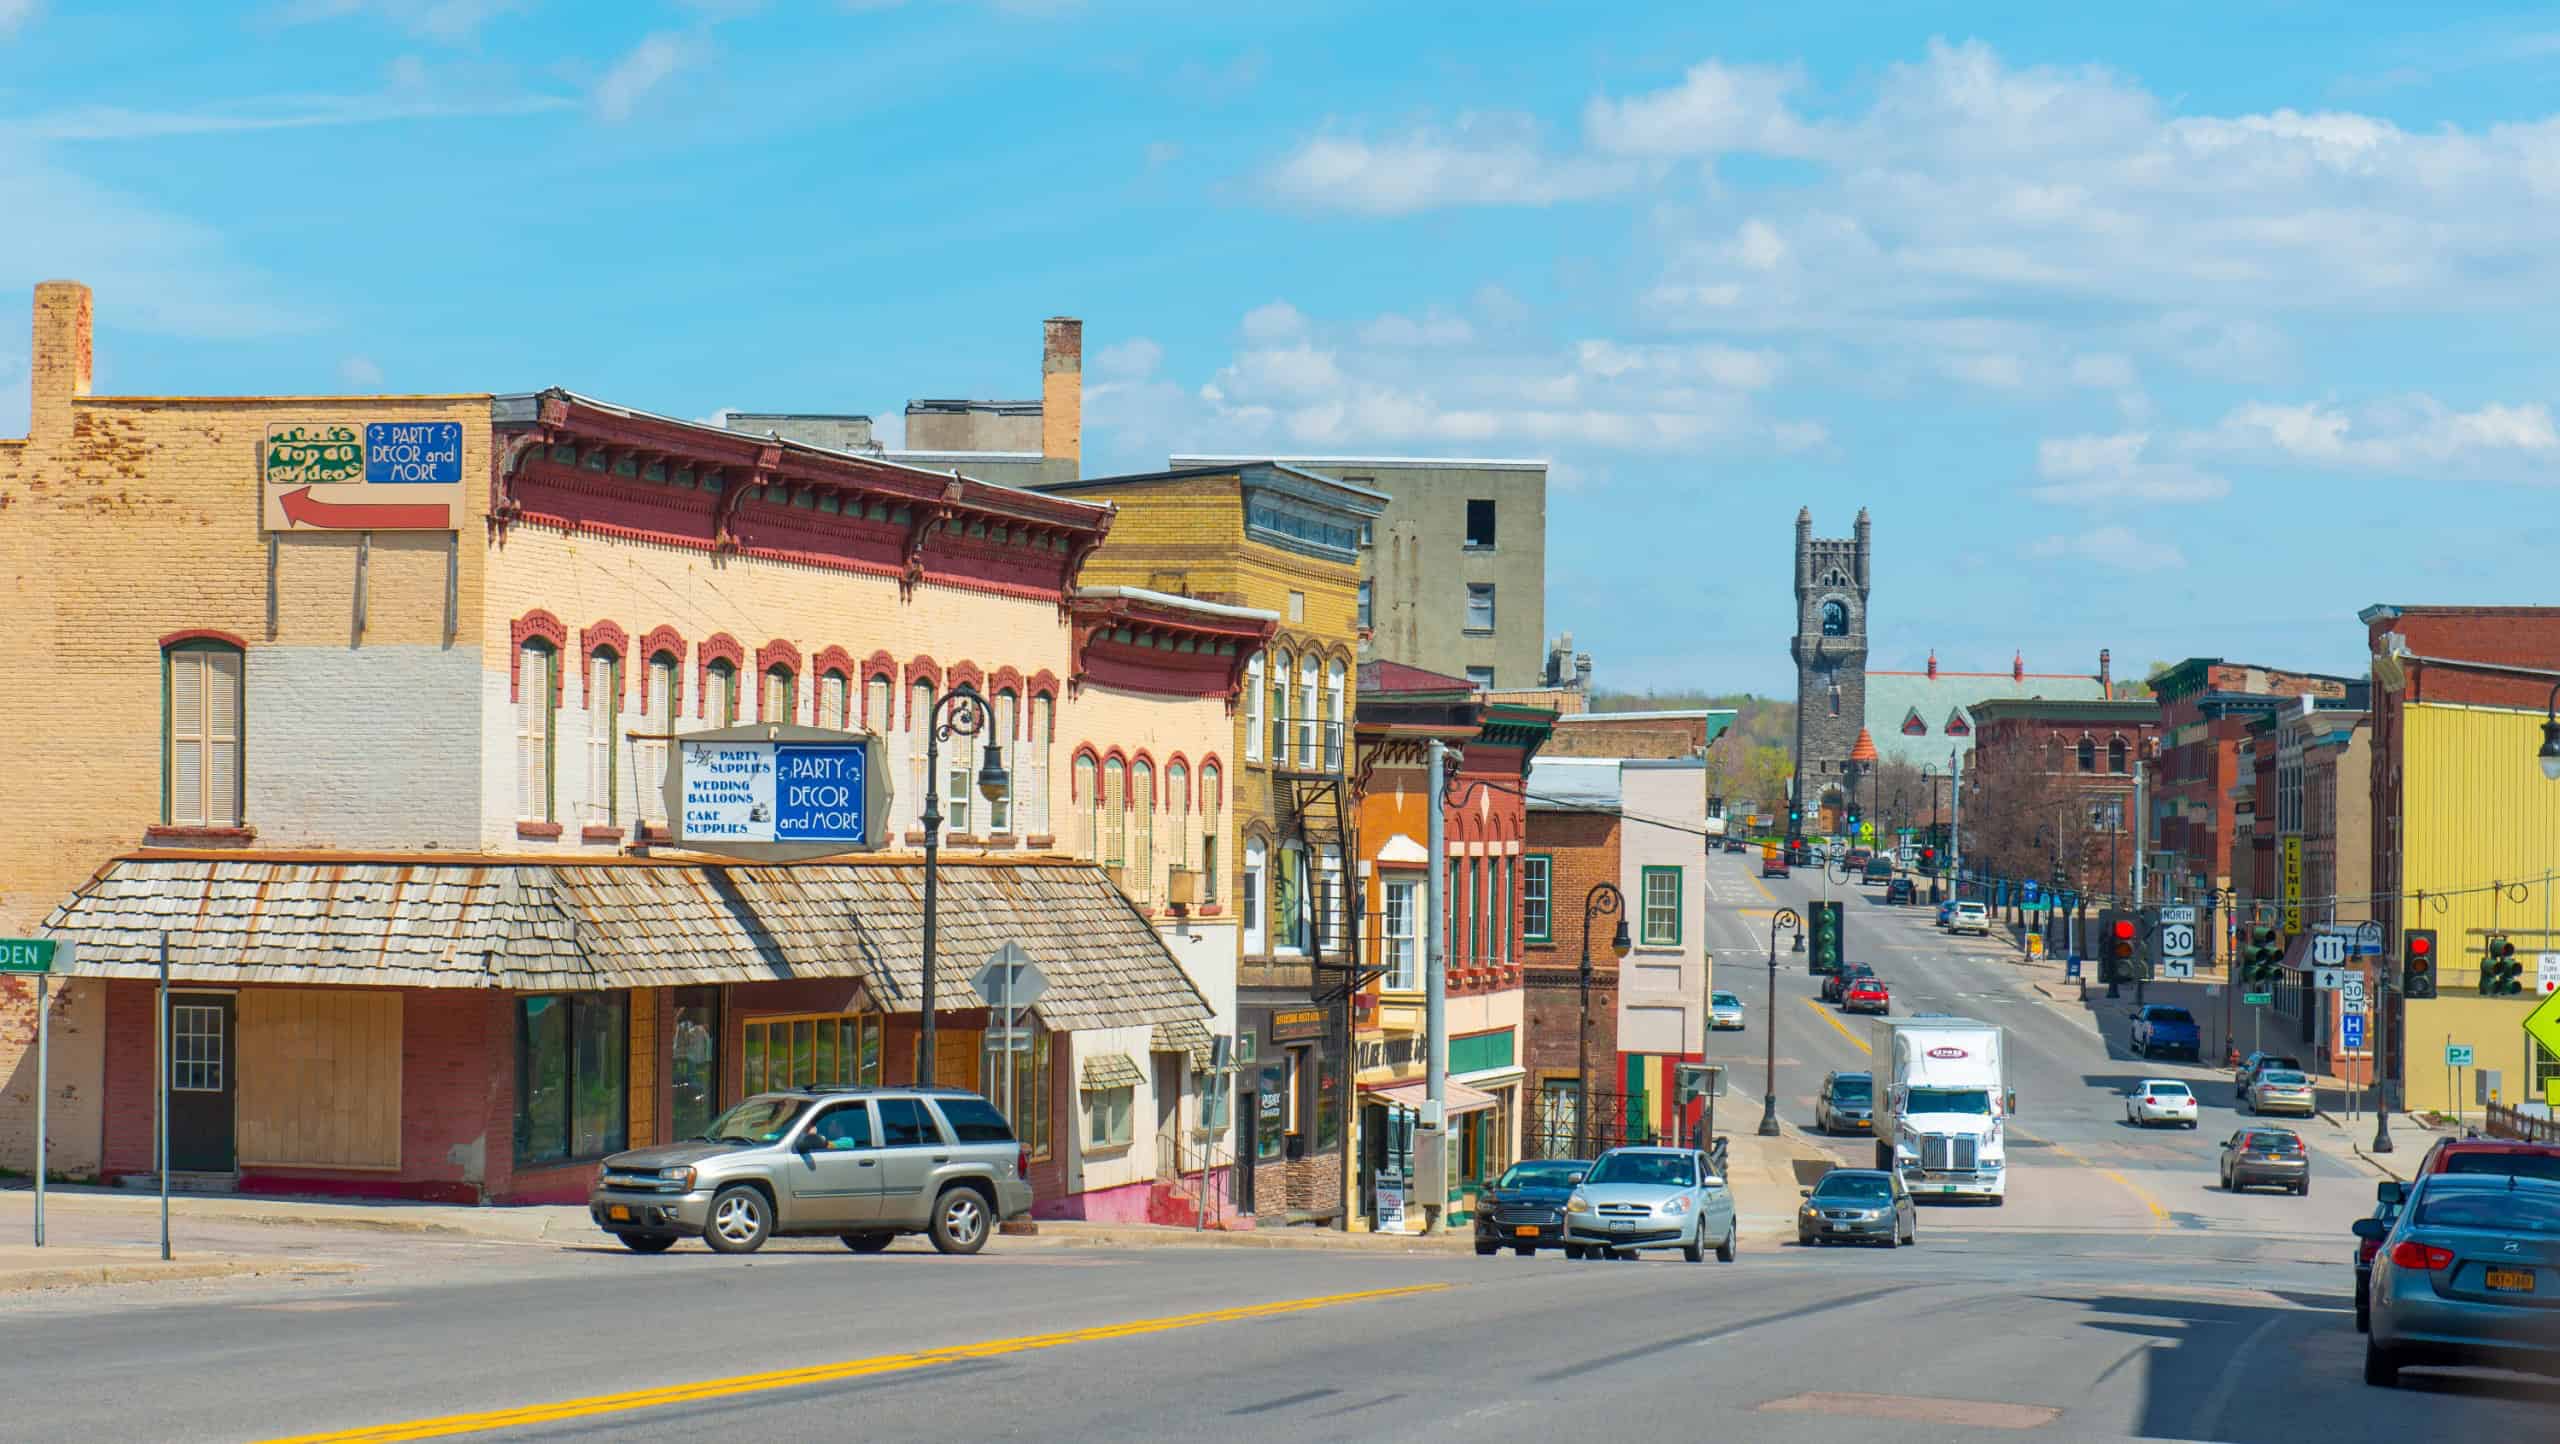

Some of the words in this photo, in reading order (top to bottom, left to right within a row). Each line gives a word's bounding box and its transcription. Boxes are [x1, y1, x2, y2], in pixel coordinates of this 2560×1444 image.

[393, 427, 434, 443] PARTY
[372, 445, 420, 462] DECOR
[425, 446, 454, 462] and
[391, 464, 437, 480] MORE
[720, 751, 760, 761] PARTY
[710, 764, 770, 774] SUPPLIES
[792, 758, 845, 779] PARTY
[692, 780, 750, 791] WEDDING
[688, 793, 754, 804] BALLOONS
[790, 786, 849, 807] DECOR
[687, 811, 720, 821] CAKE
[780, 811, 809, 830] and
[812, 813, 859, 830] MORE
[686, 824, 748, 834] SUPPLIES
[2163, 910, 2192, 921] NORTH
[2166, 931, 2191, 950] 30
[2323, 942, 2337, 960] 11
[2346, 988, 2362, 997] 30
[2347, 1018, 2360, 1033] H
[2450, 1048, 2461, 1062] P
